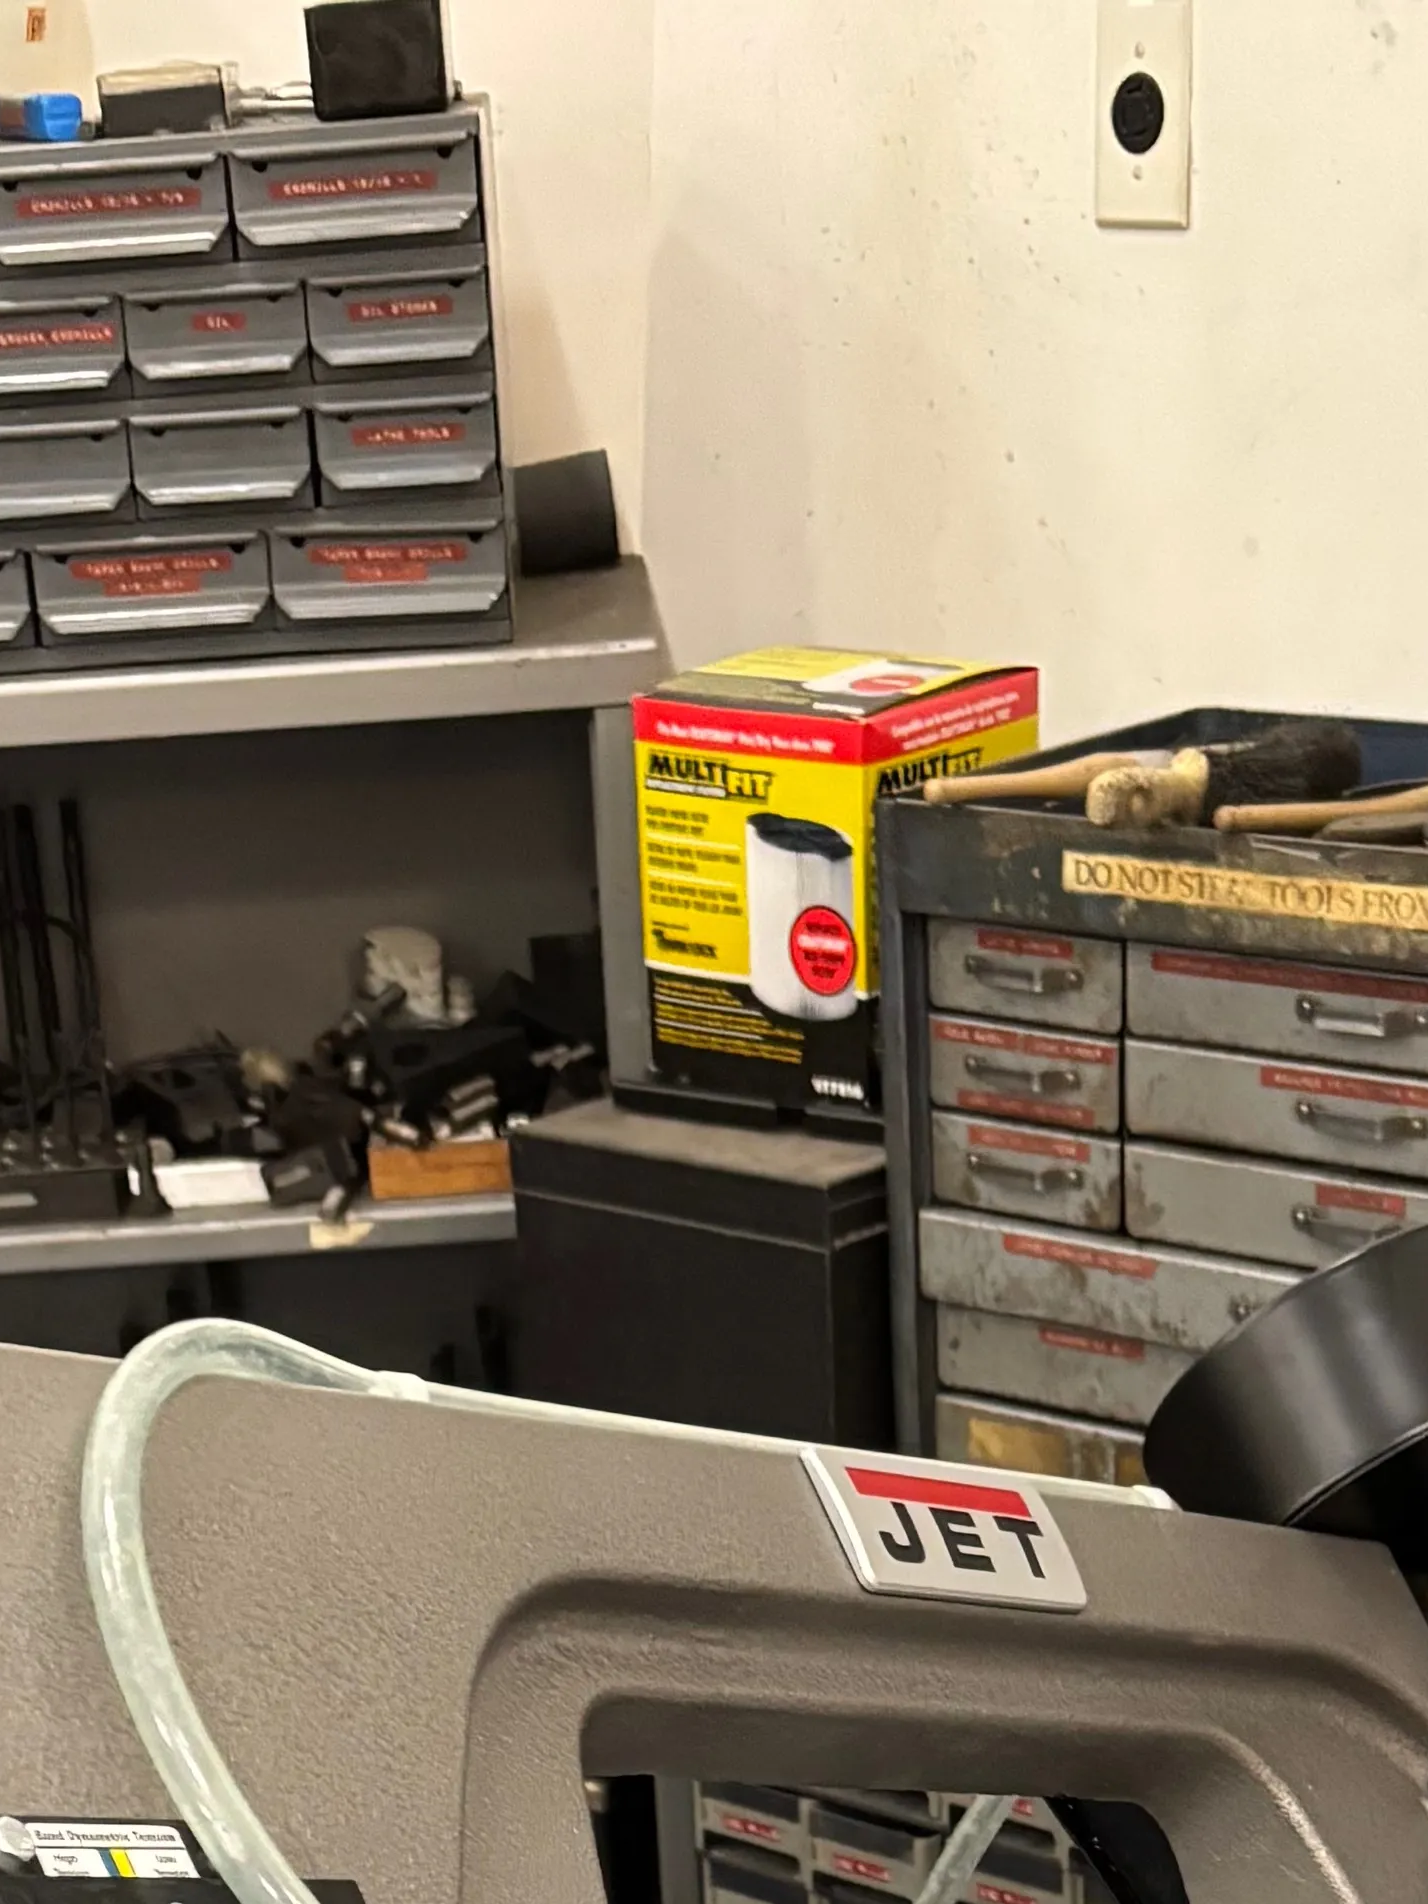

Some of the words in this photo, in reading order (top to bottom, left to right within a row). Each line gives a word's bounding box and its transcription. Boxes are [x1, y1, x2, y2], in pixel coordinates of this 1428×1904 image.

[1075, 858, 1113, 888] DO
[1118, 864, 1172, 895] NOT
[878, 1501, 1046, 1580] JET
